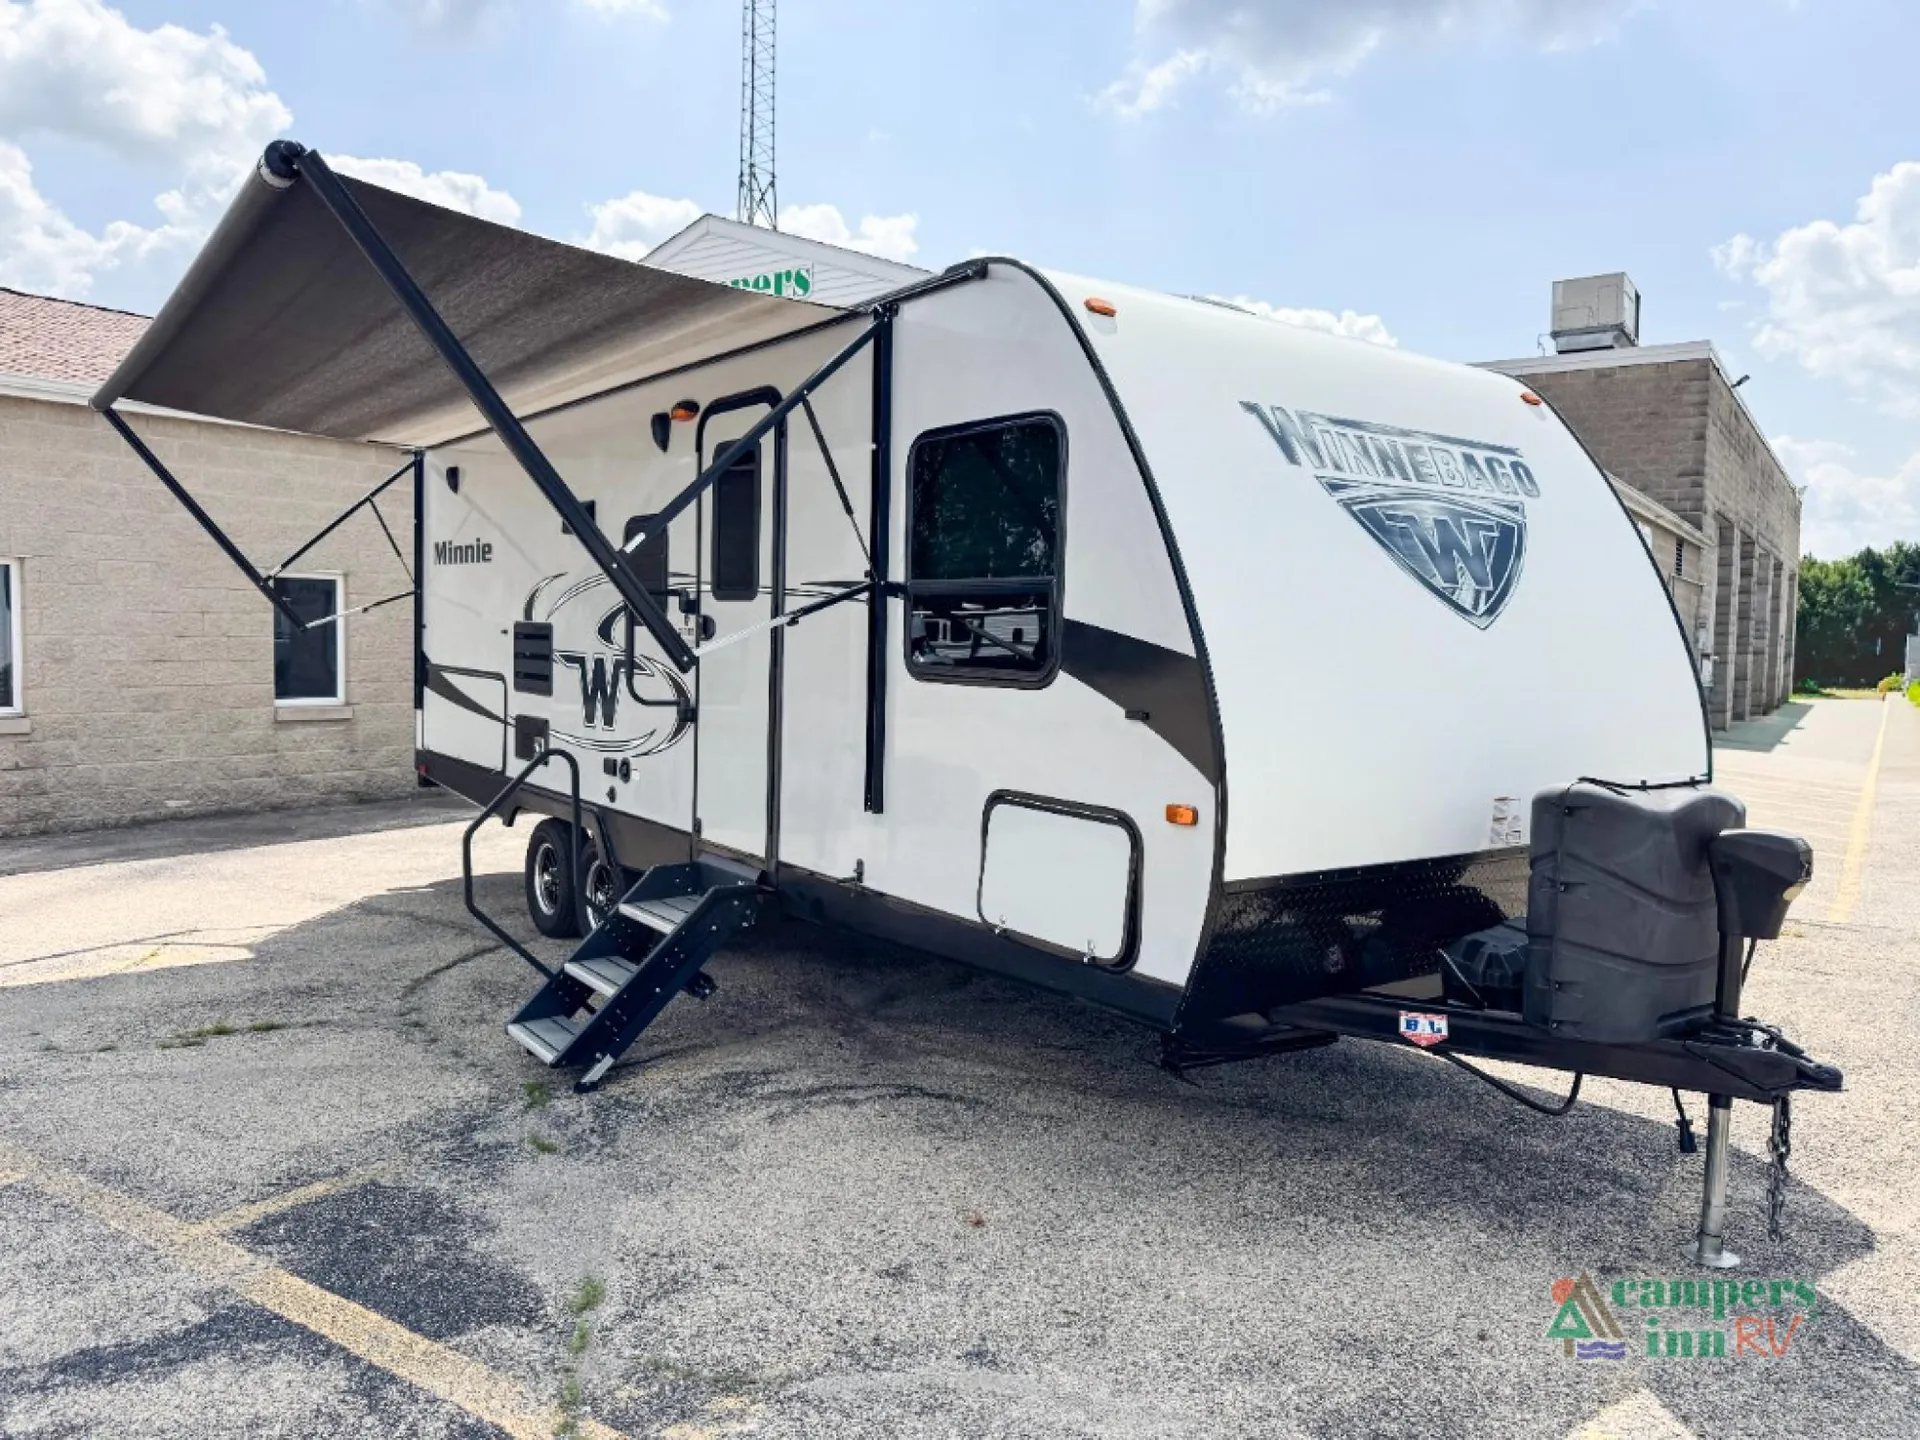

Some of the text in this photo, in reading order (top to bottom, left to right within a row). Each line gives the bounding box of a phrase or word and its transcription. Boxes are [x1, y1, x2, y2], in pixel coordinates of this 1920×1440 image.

[1239, 401, 1541, 498] WINNEBAGO
[434, 538, 493, 565] Minnie
[1377, 510, 1500, 589] W
[553, 651, 655, 731] W
